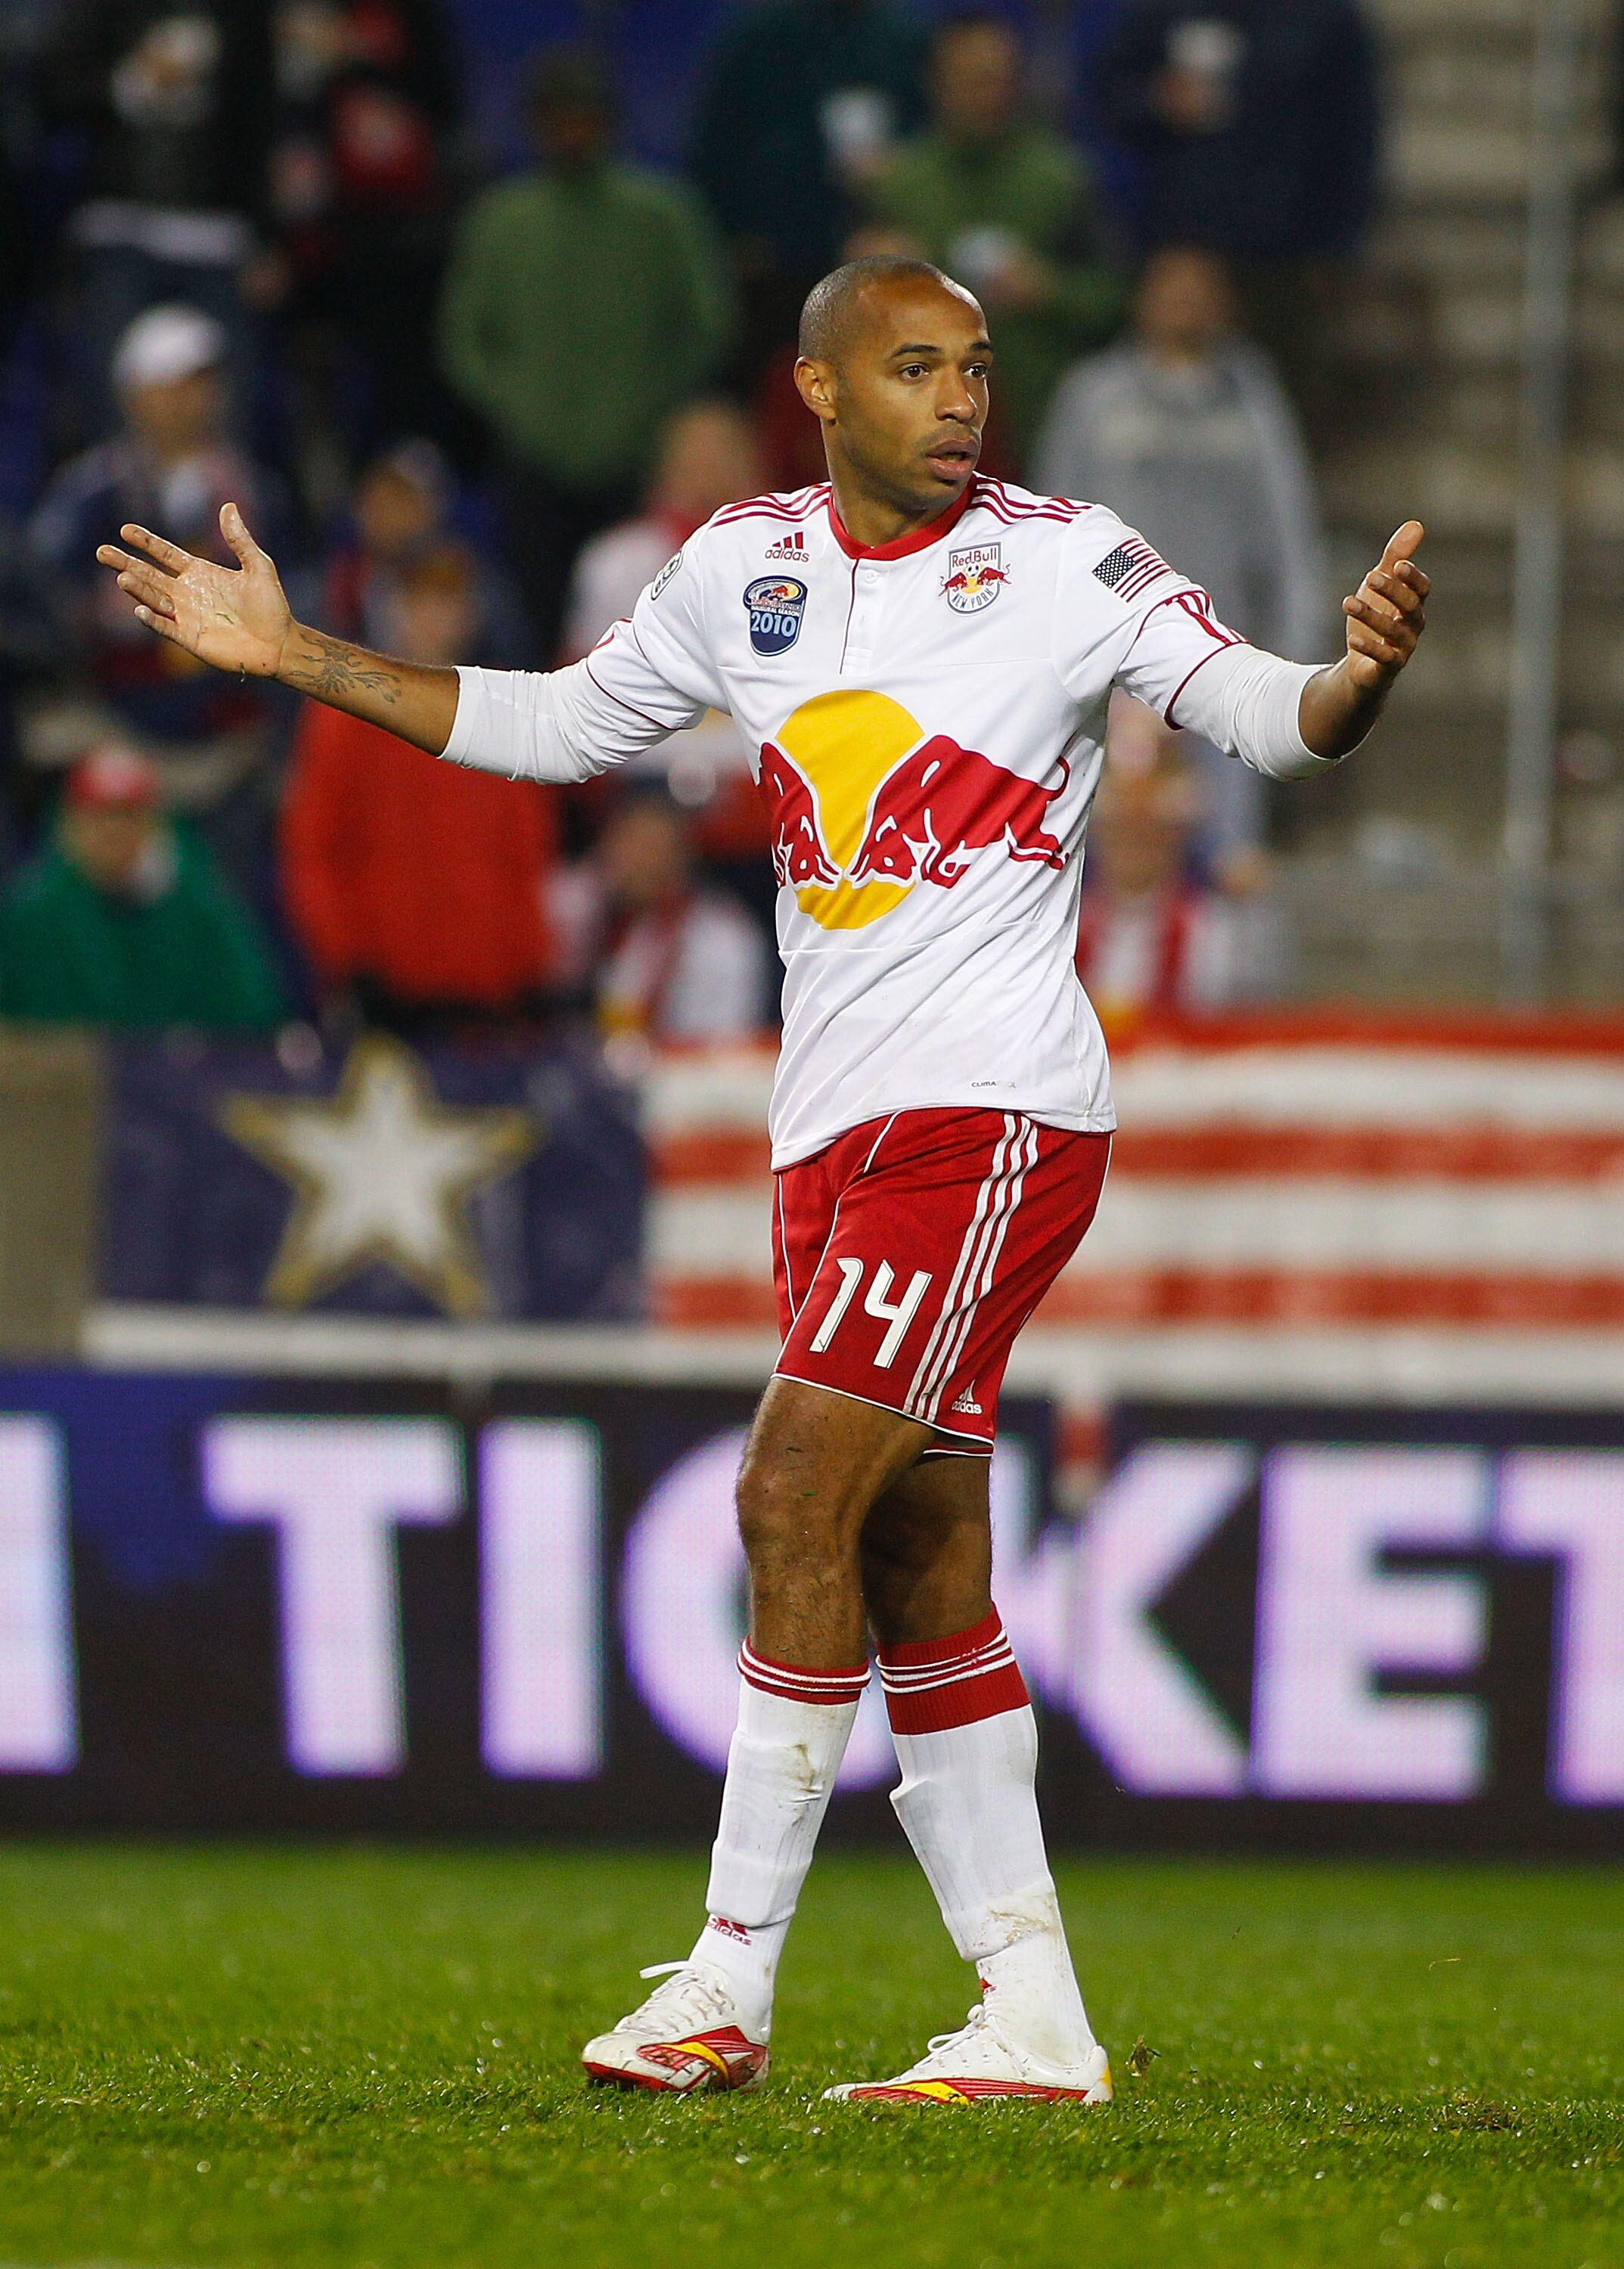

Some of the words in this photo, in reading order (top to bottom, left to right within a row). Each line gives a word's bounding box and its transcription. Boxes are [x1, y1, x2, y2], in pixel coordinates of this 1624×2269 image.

[765, 548, 810, 563] adidas
[952, 593, 967, 608] NEW
[971, 588, 994, 608] YORK
[751, 612, 796, 638] 2010
[809, 1257, 933, 1369] 14
